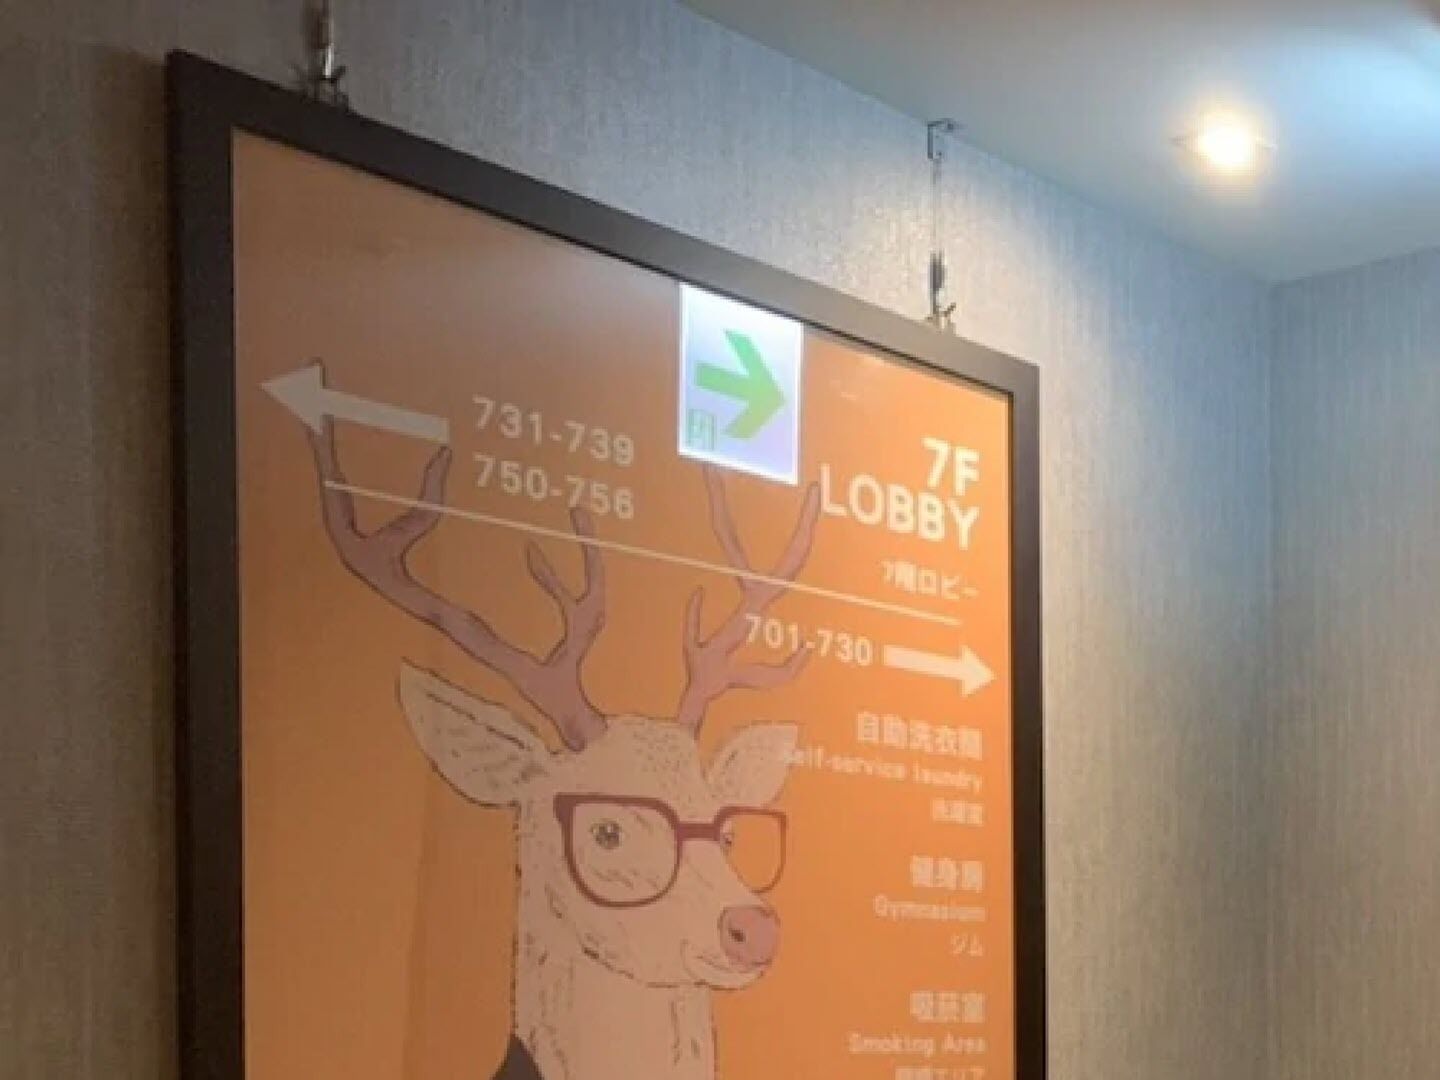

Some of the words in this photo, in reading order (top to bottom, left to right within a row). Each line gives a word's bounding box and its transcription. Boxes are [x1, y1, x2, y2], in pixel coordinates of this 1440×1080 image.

[472, 394, 635, 468] 731-739
[472, 453, 635, 520] 750-756
[920, 436, 980, 497] 7F
[820, 463, 980, 550] LOBBY
[744, 612, 874, 667] 701-730
